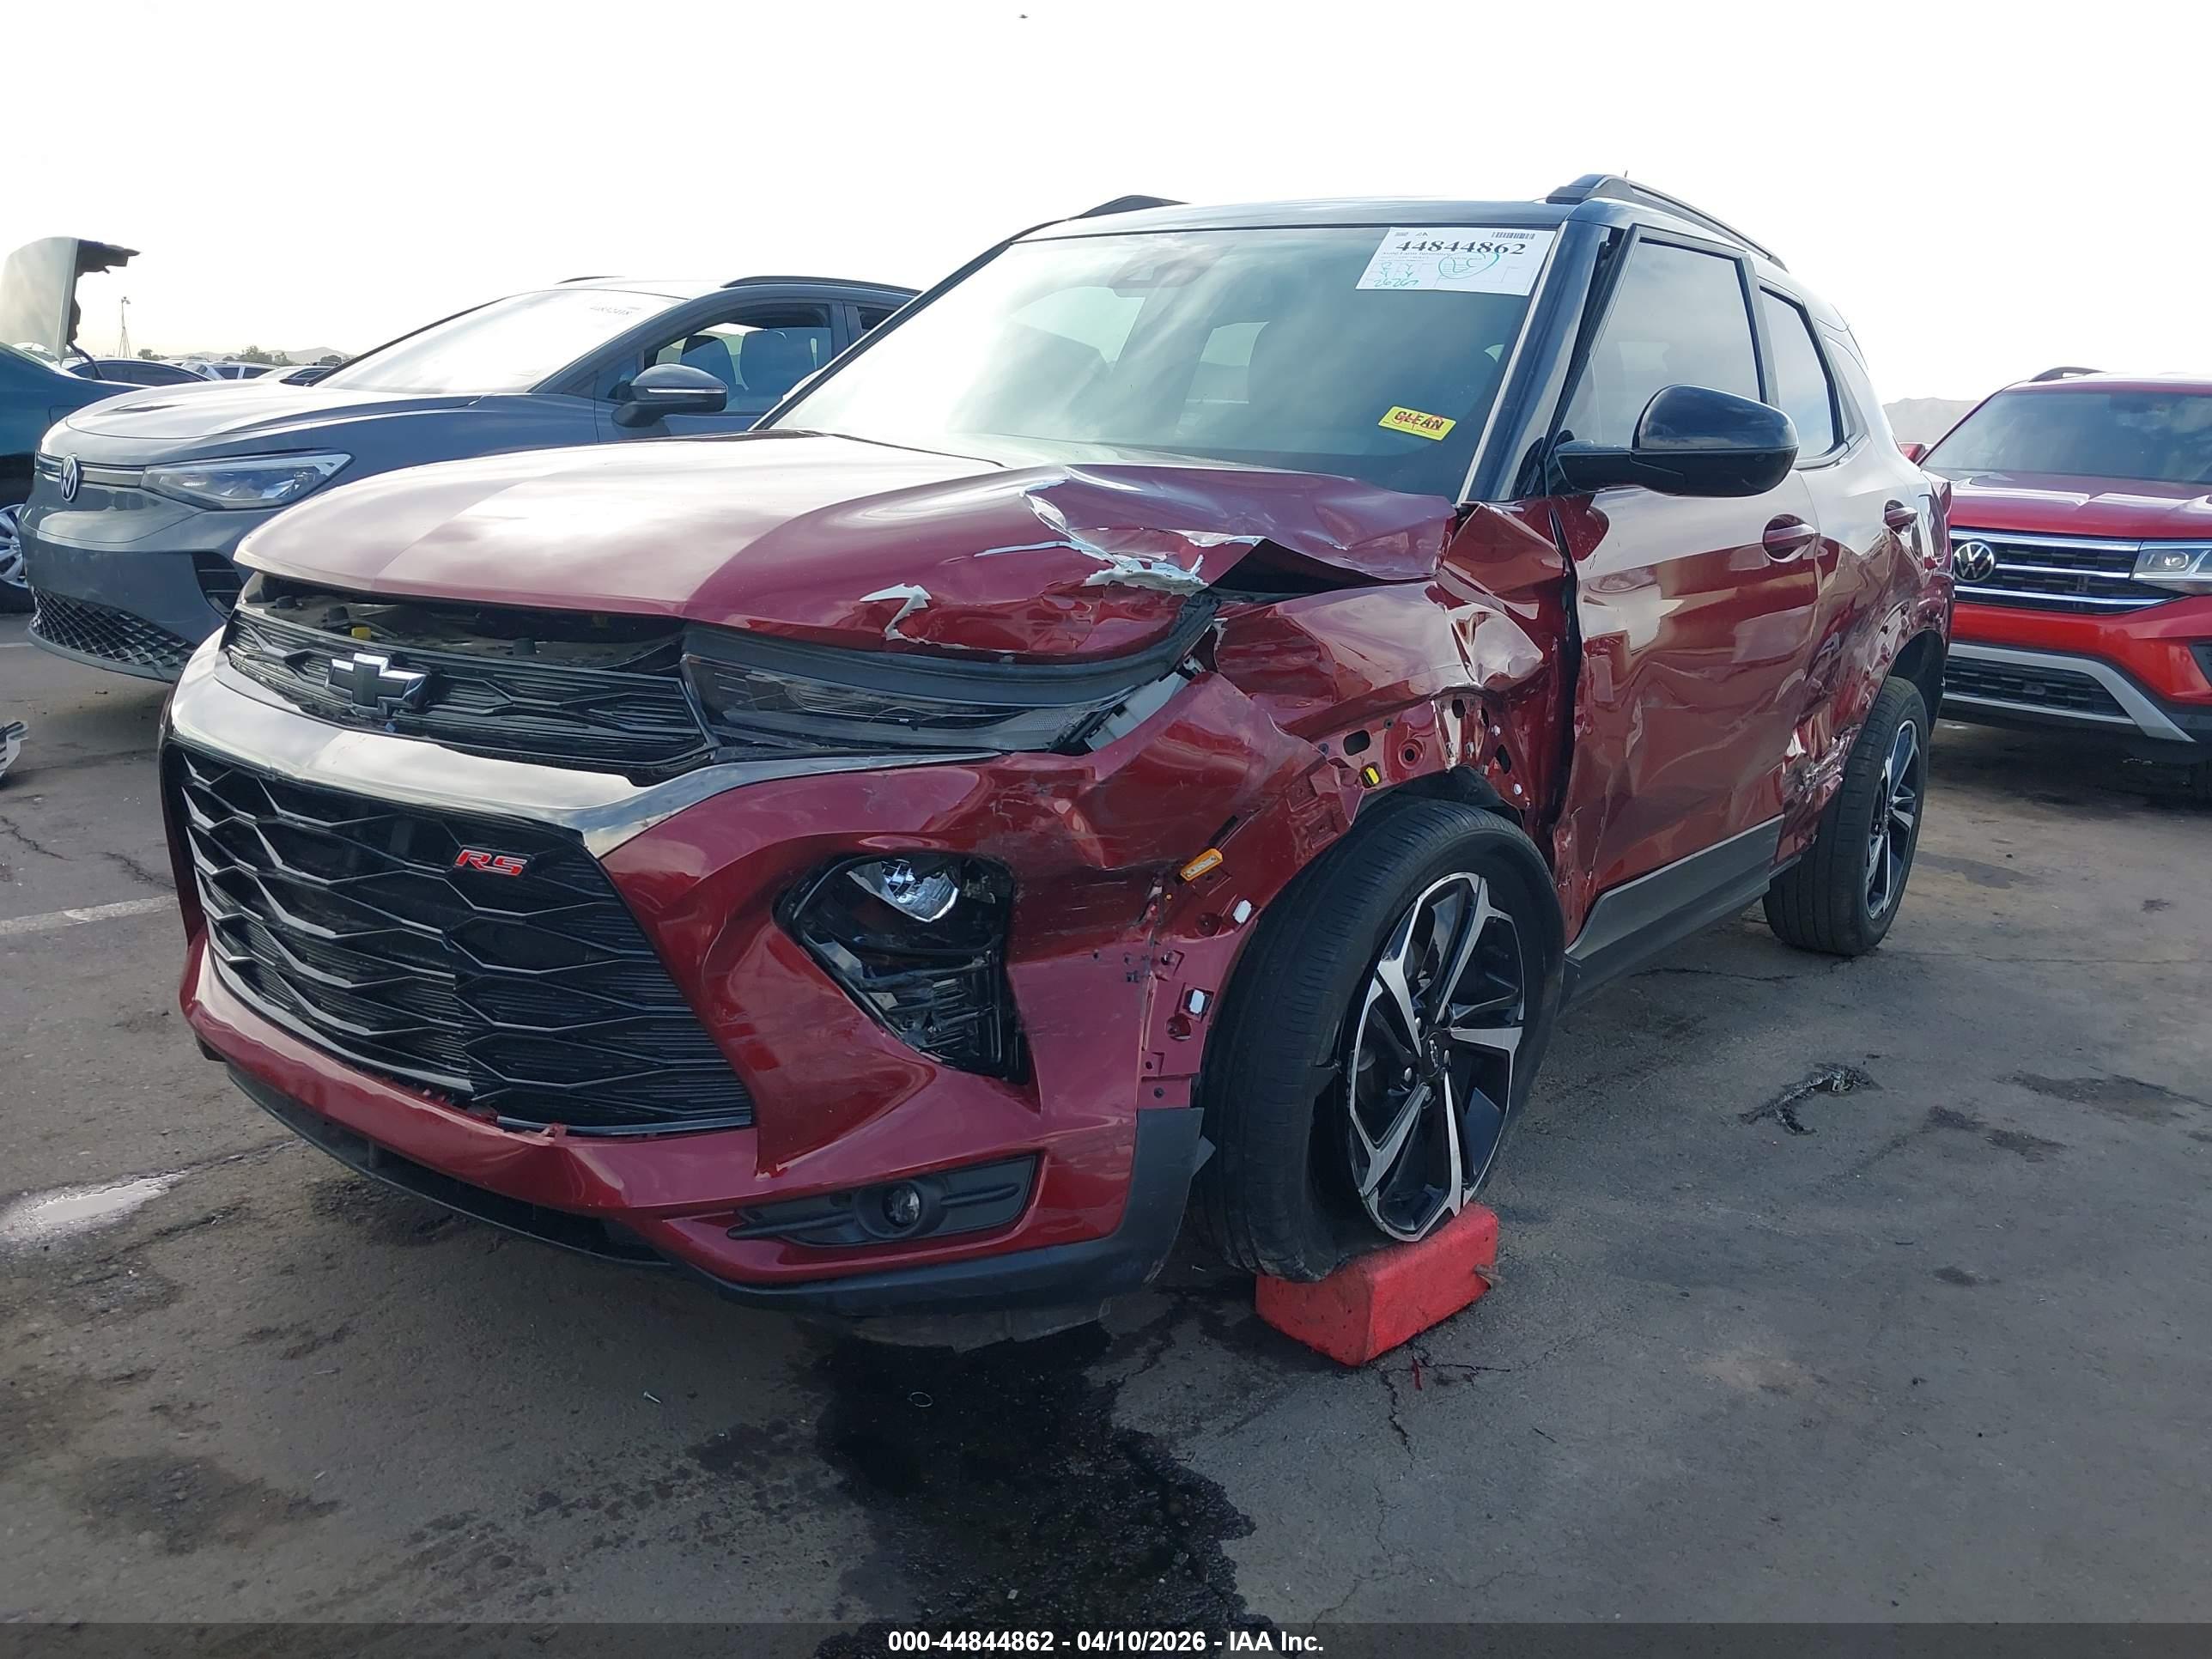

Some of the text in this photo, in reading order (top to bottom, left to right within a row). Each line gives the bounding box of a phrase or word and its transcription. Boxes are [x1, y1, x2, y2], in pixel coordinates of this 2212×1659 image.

[1395, 240, 1527, 255] 44844862
[1394, 410, 1444, 429] CLEAN
[454, 848, 528, 876] RS
